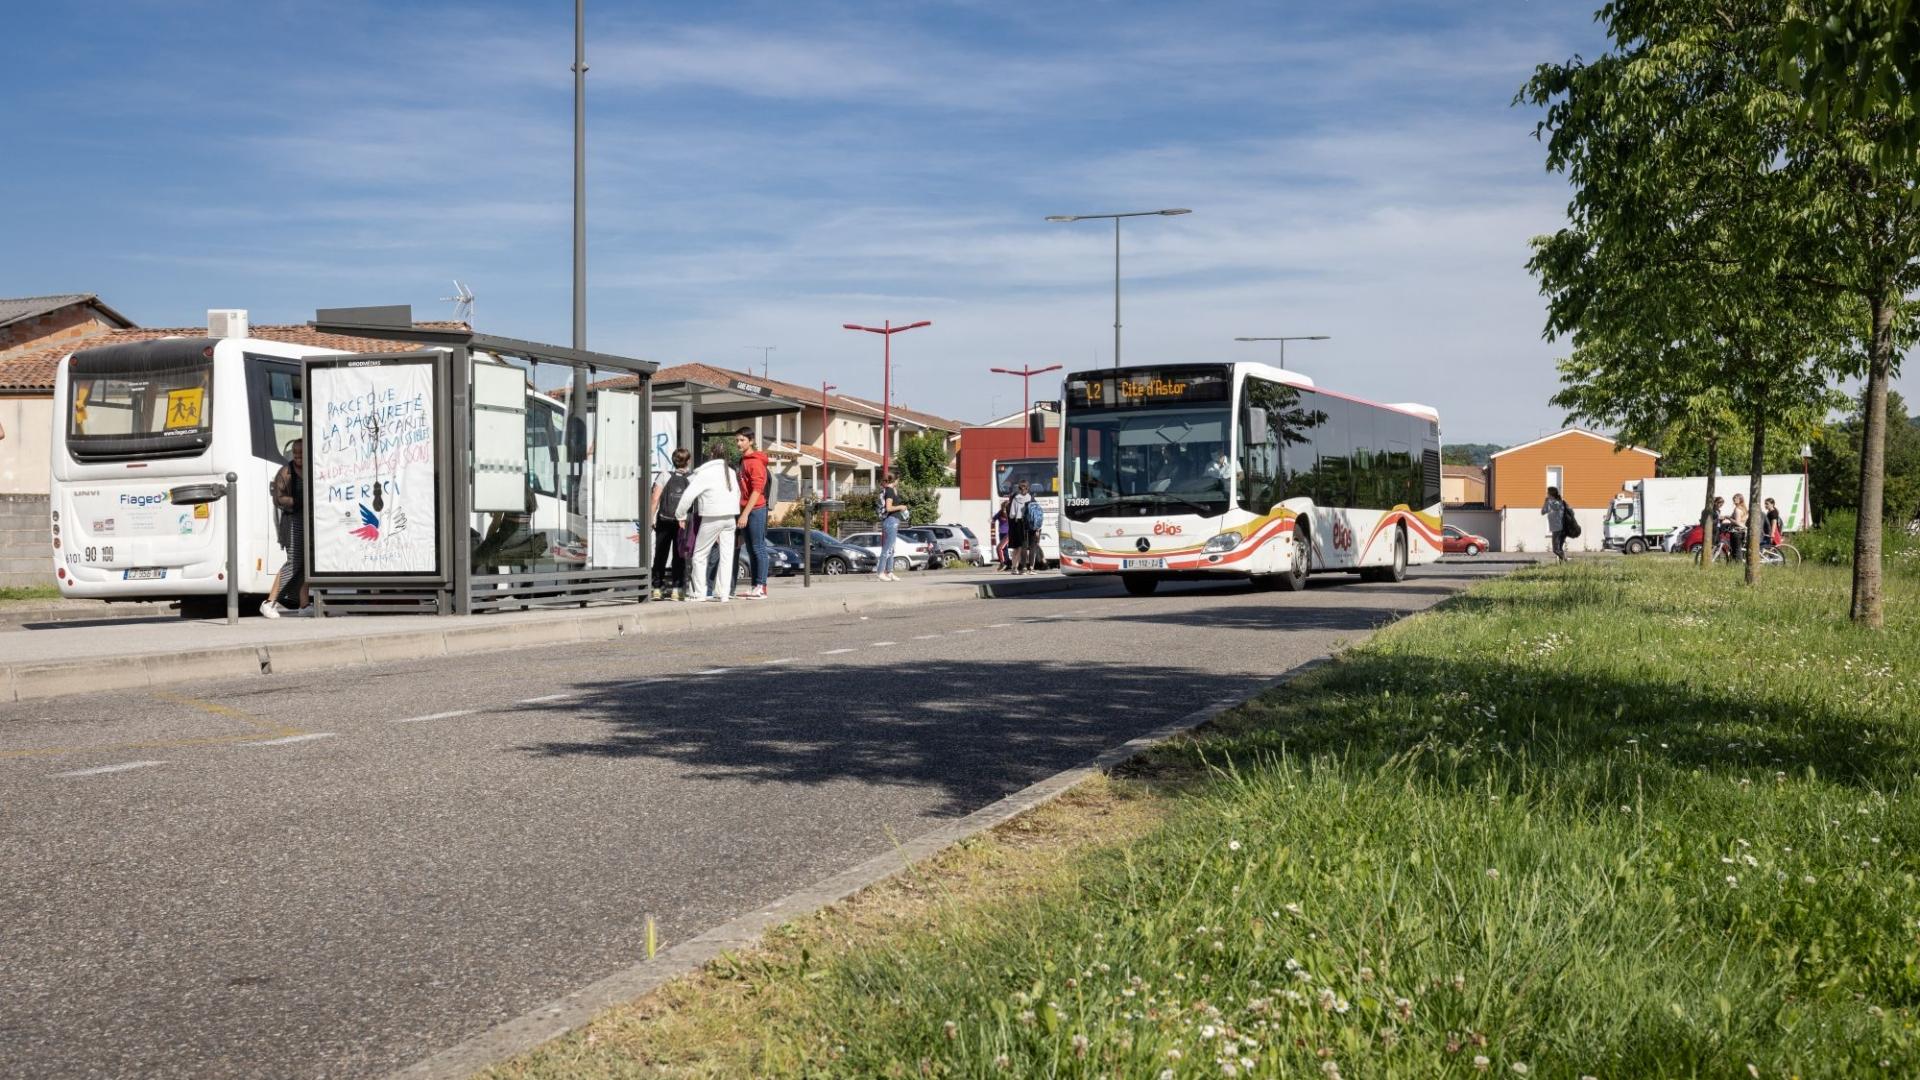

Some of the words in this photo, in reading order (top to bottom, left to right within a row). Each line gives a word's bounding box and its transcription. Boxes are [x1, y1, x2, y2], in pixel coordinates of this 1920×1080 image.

[1146, 379, 1186, 396] d'Astor
[328, 395, 364, 420] PARCE
[367, 388, 395, 406] QUE
[322, 424, 339, 441] LA
[328, 480, 400, 503] MERCI
[1067, 498, 1090, 506] 73099
[1153, 520, 1182, 536] élios
[85, 546, 97, 562] 90
[102, 546, 114, 562] 100
